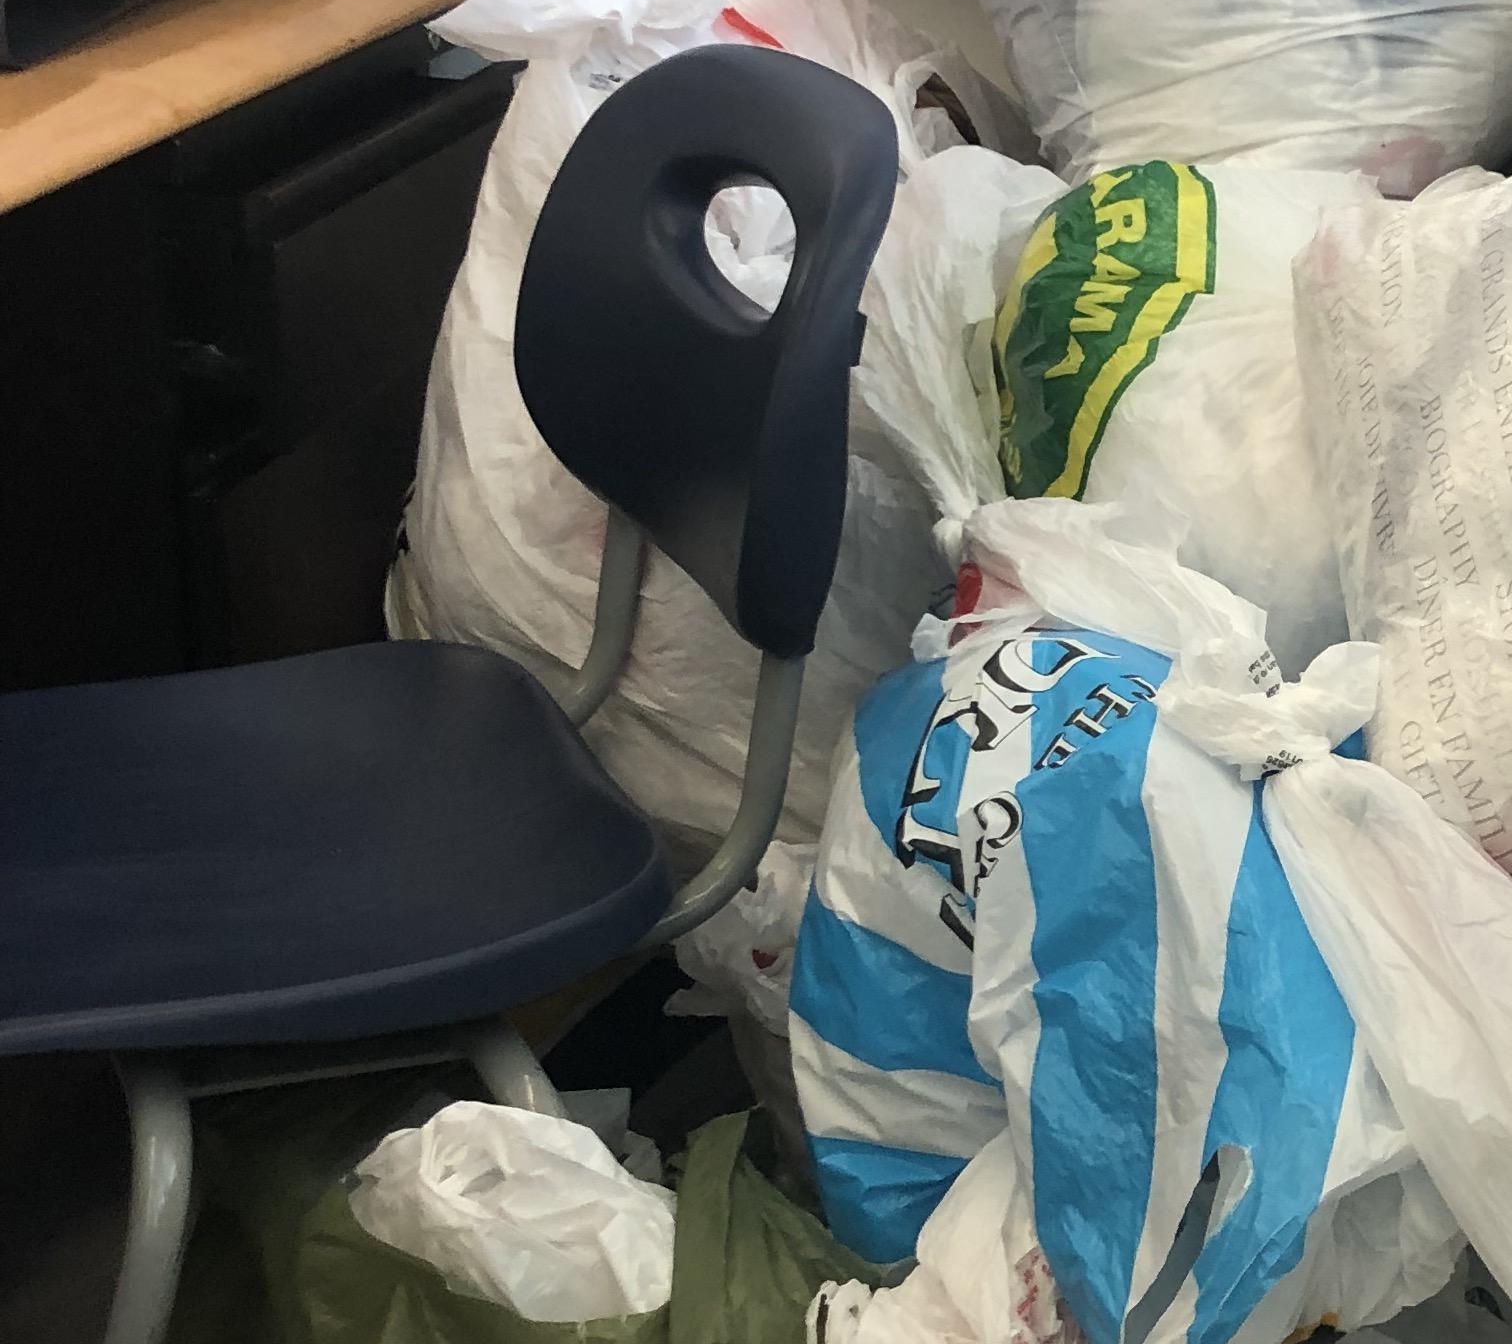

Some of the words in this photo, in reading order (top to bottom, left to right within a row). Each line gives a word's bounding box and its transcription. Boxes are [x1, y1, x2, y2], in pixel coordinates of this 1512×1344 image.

[1415, 394, 1483, 593] BIOGRAPHY
[1410, 555, 1450, 669] DÎNER
[1421, 671, 1463, 726] EN
[1392, 717, 1445, 812] GIFT
